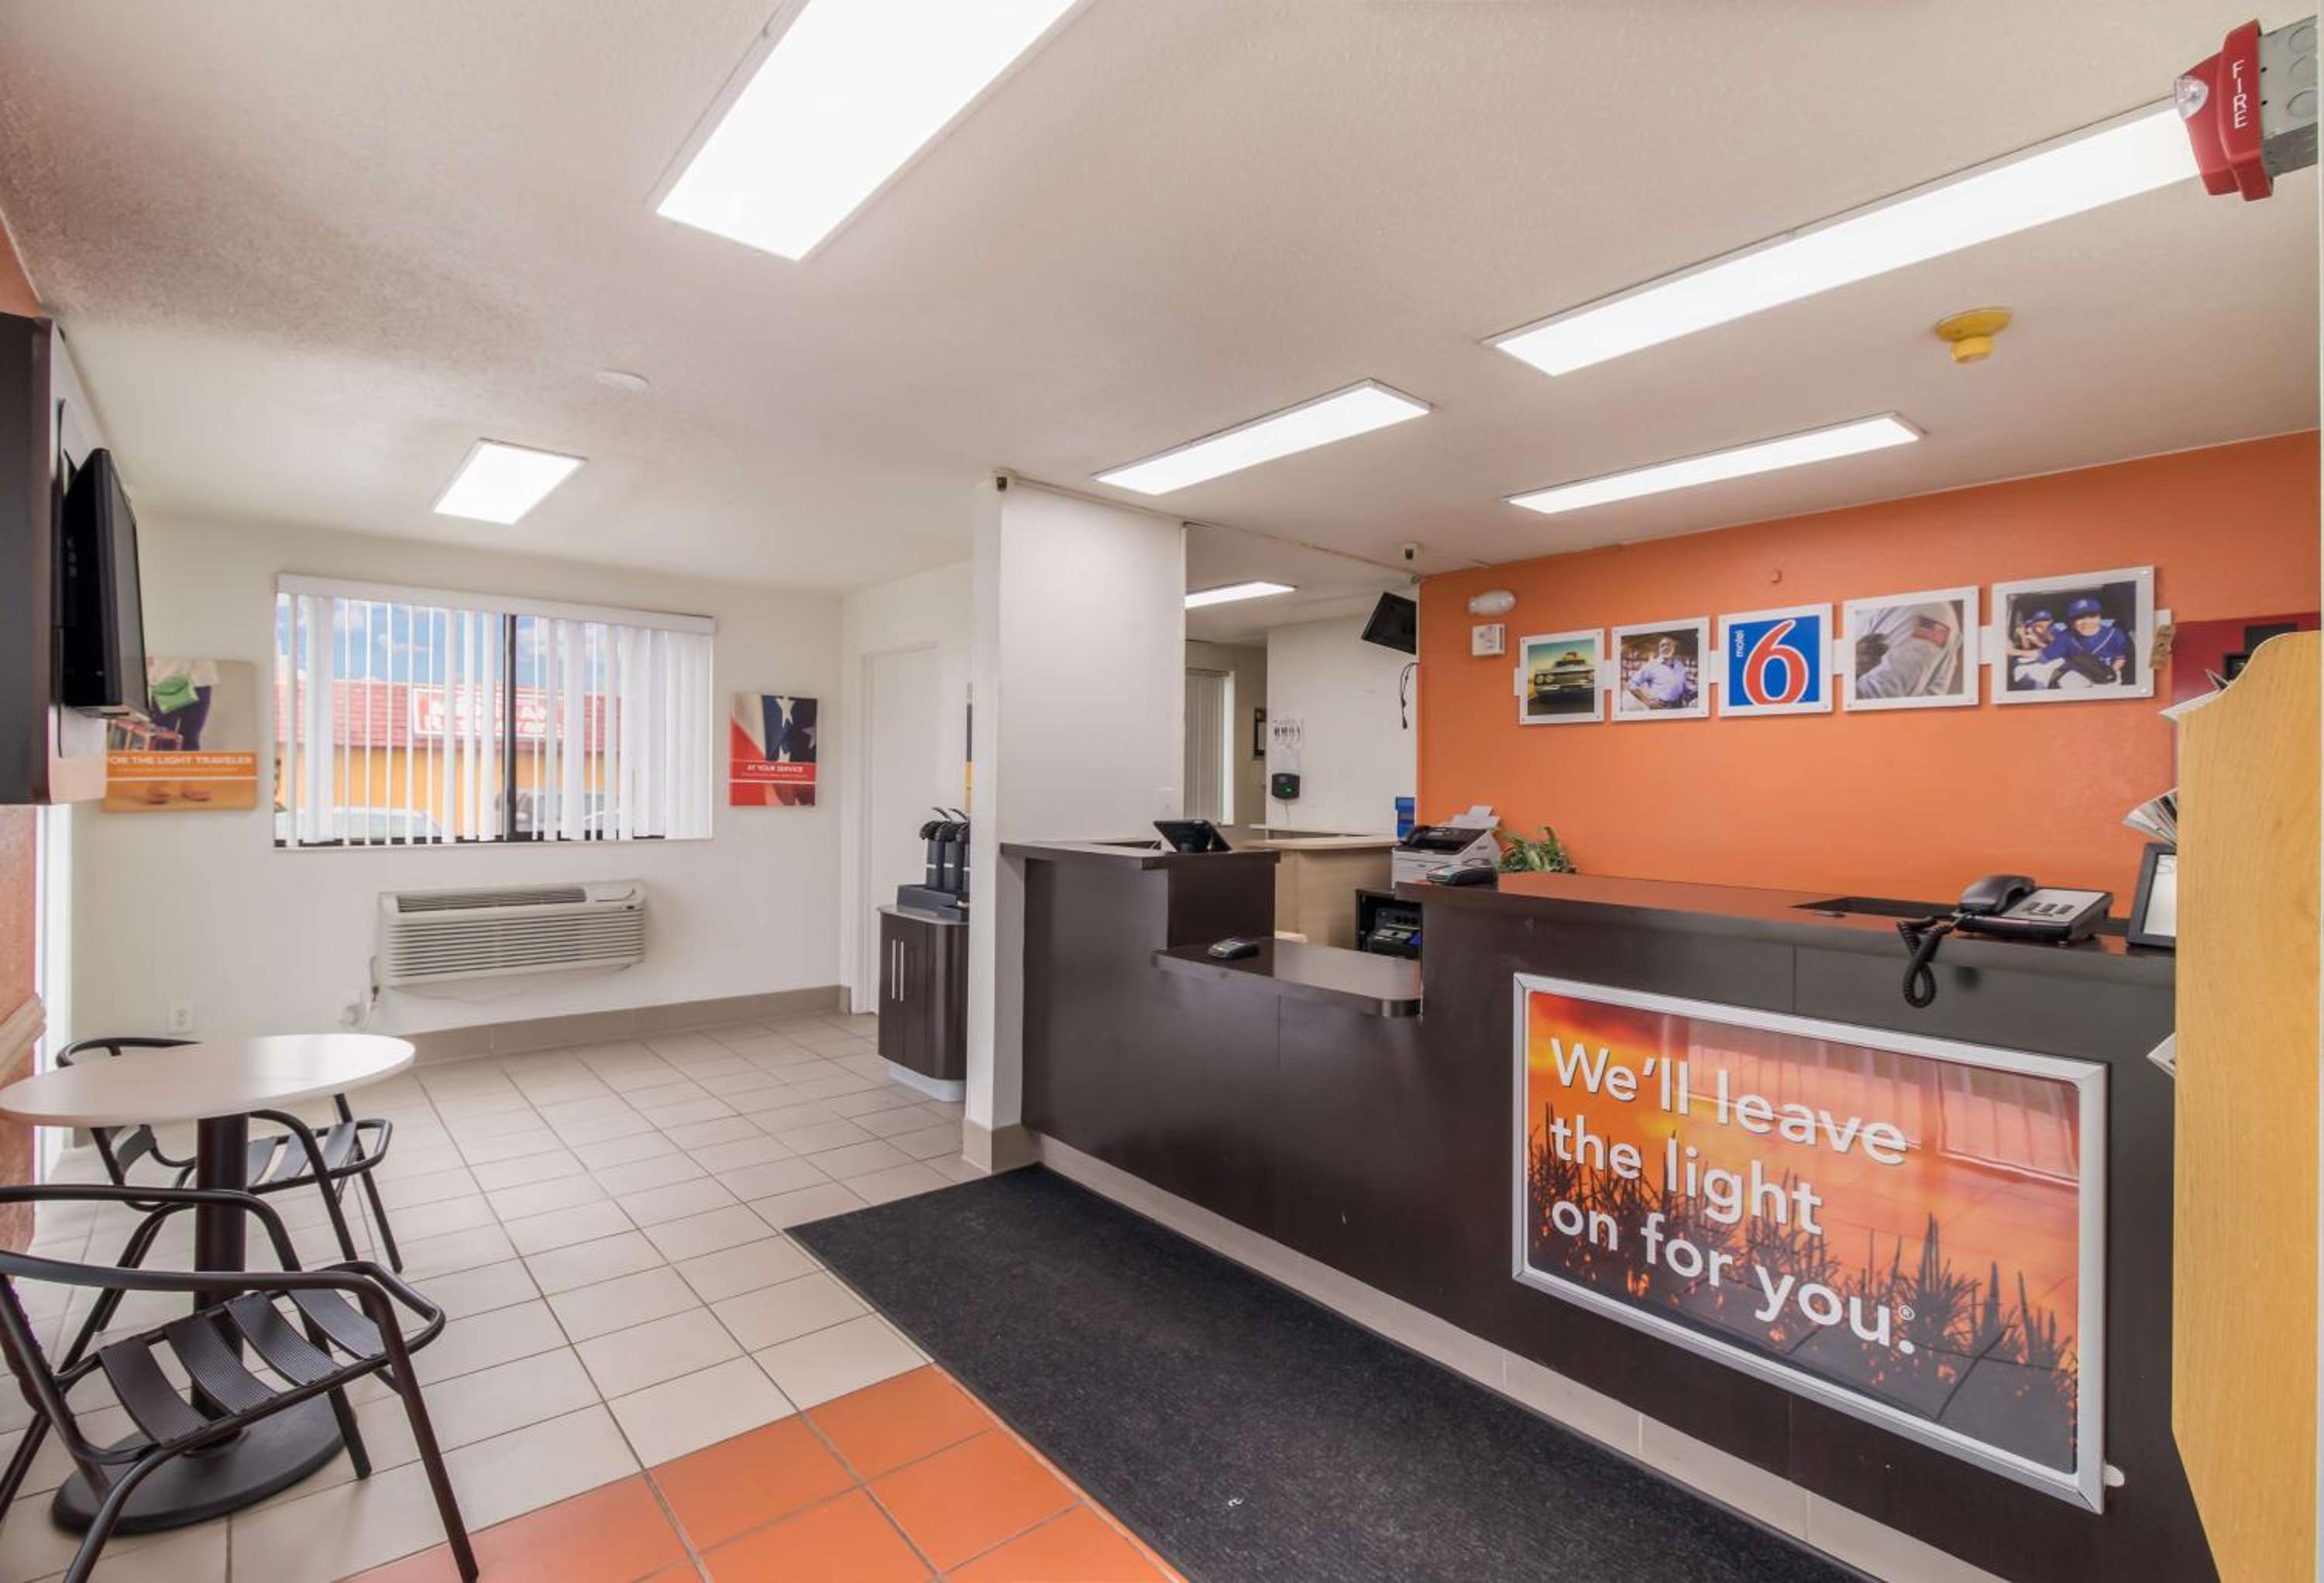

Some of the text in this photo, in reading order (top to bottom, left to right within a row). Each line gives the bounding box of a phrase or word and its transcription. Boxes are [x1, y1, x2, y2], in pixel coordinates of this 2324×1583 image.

[2231, 59, 2248, 129] FIRE
[1734, 619, 1810, 706] motel 6
[158, 756, 193, 765] LIGHT
[195, 756, 254, 765] TRAVELER
[1551, 1038, 1908, 1165] We’ll leave
[1549, 1115, 1822, 1234] the light
[1552, 1200, 1618, 1251] on
[1640, 1212, 1733, 1288] for
